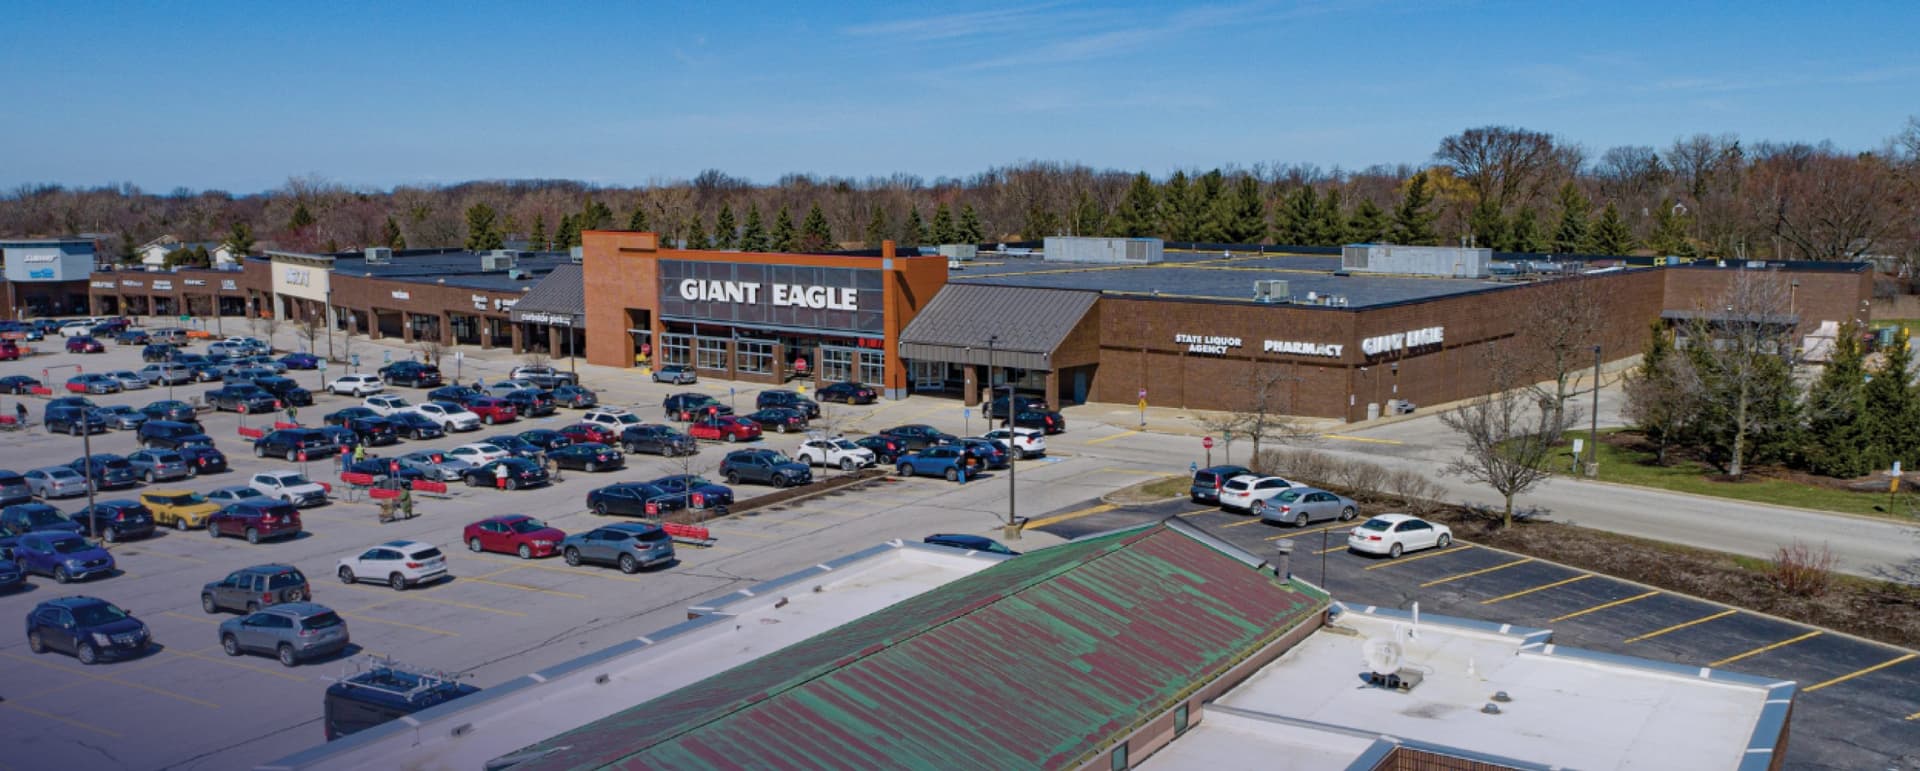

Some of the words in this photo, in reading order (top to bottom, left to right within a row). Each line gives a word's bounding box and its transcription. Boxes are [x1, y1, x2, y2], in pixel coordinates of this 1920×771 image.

[679, 278, 761, 305] GIANT
[772, 283, 858, 311] EAGLE
[1175, 334, 1202, 345] STATE
[1205, 335, 1242, 347] LIQUOR
[1189, 344, 1229, 355] AGENCY
[1264, 340, 1344, 357] PHARMACY
